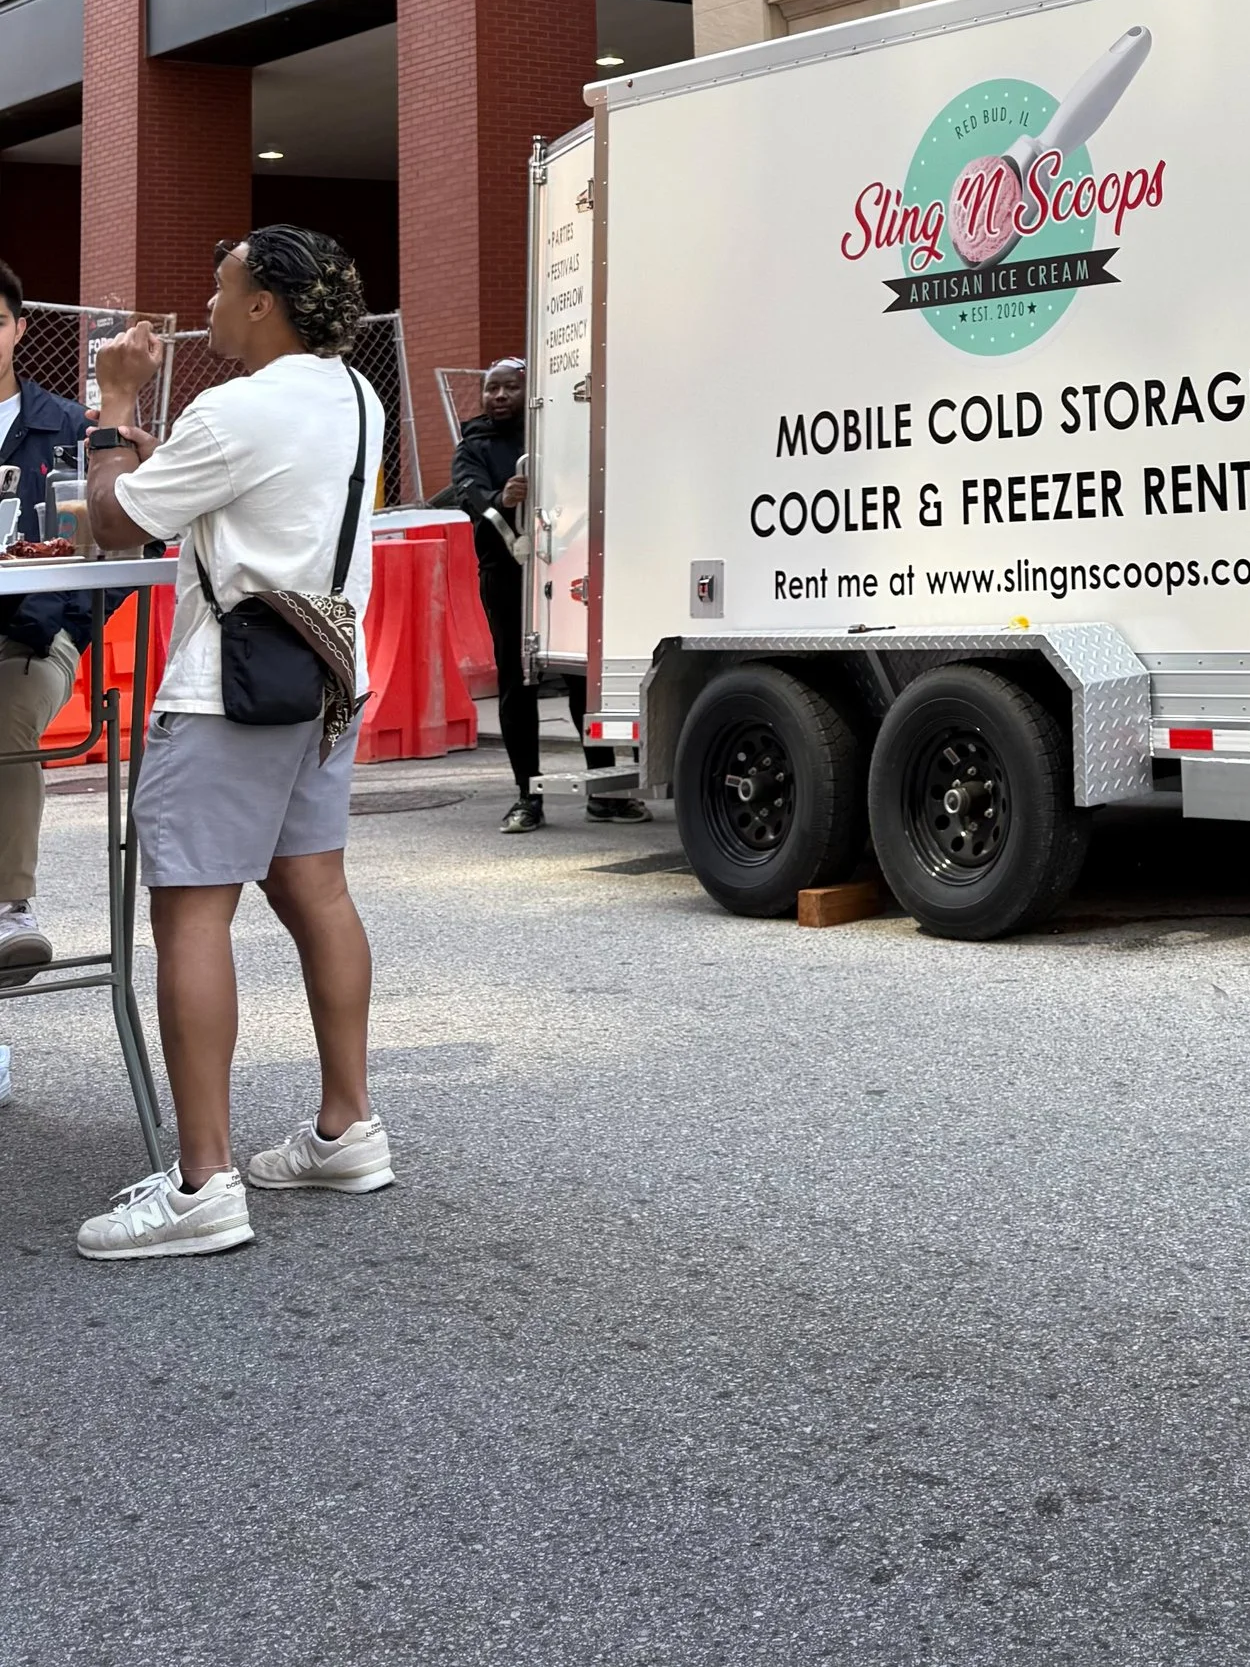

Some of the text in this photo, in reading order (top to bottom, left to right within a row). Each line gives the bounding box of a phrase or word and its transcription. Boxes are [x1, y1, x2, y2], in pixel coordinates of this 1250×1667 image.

[954, 106, 1031, 140] RED BUD, IL
[841, 181, 945, 271] Sling
[1013, 150, 1167, 237] Scoops
[551, 222, 575, 249] PARTIES
[550, 253, 581, 283] FESTIVALS
[909, 259, 1090, 303] ARTISAN ICE CREAM
[549, 285, 584, 316] OVERFLOW
[971, 301, 1025, 323] EST. 2020
[549, 318, 588, 349] EMERGENCY
[549, 348, 580, 376] RESPONSE
[776, 402, 912, 458] MOBILE
[928, 391, 1043, 445] COLD
[750, 484, 903, 538] COOLER
[918, 482, 942, 527] &
[962, 470, 1124, 525] FREEZER
[774, 567, 828, 600] Rent
[837, 572, 879, 598] me
[889, 564, 915, 596] at
